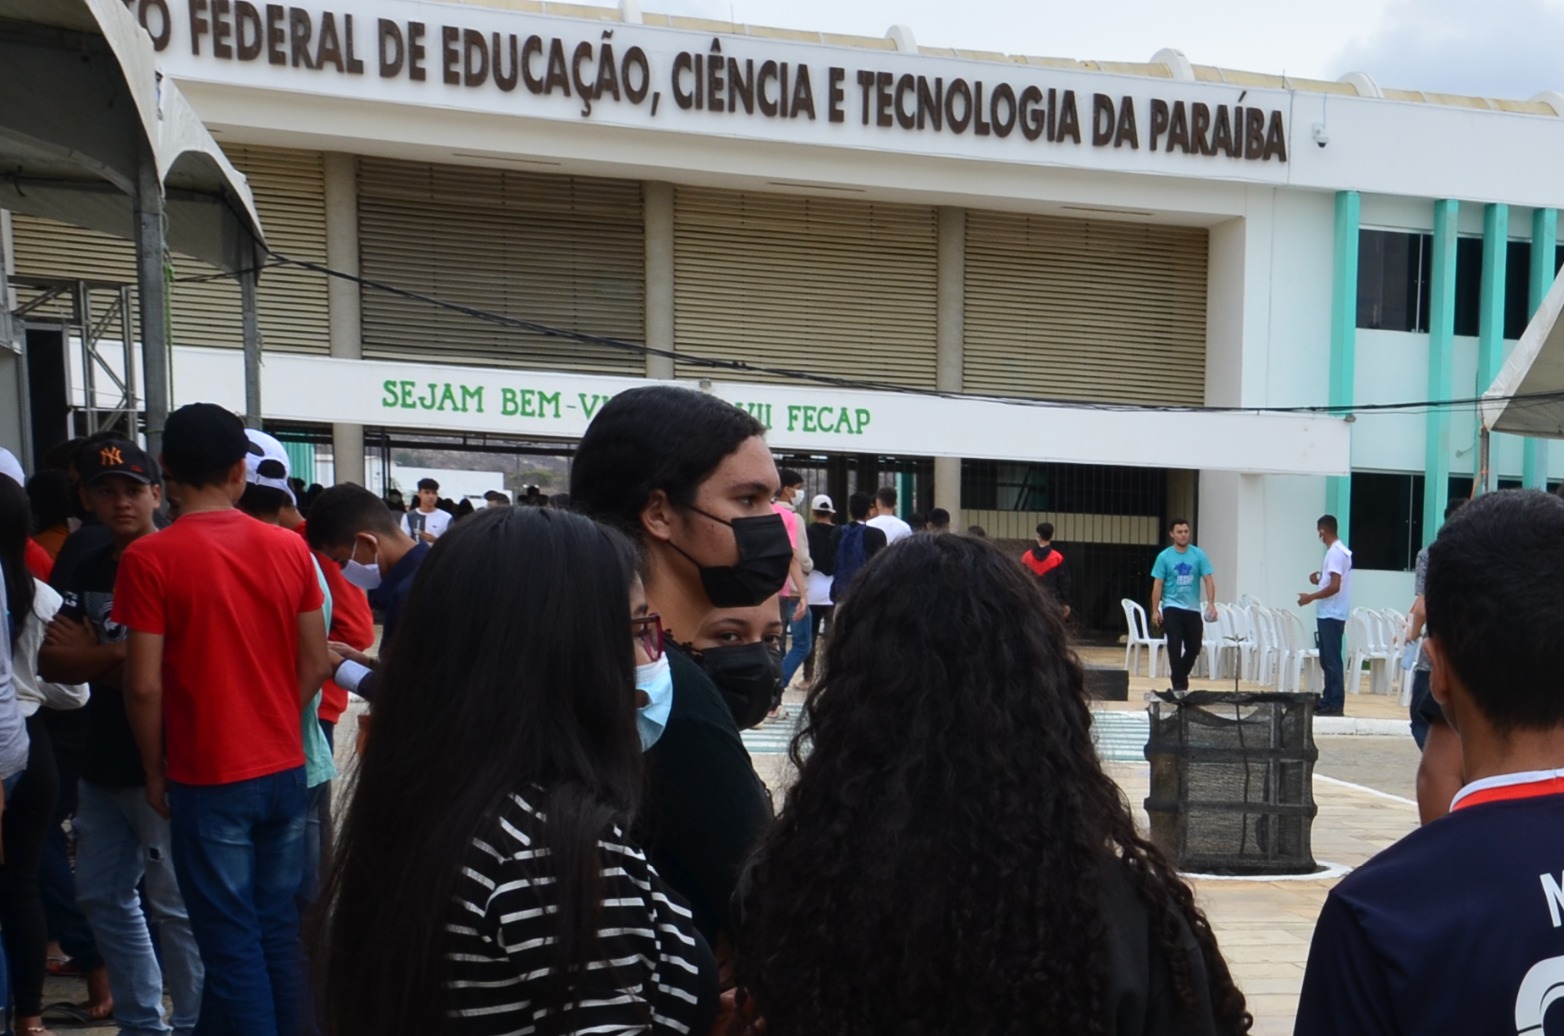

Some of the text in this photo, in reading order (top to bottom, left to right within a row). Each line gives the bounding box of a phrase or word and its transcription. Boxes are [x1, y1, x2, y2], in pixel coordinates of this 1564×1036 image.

[124, 0, 1287, 162] O FEDERAL DE EDUCAÇÃO, CIÊNCIA E TECNOLOGIA DA PARAÍBA
[382, 380, 484, 413] SEJAM
[501, 387, 613, 420] BEM-V
[787, 405, 870, 434] FECAP
